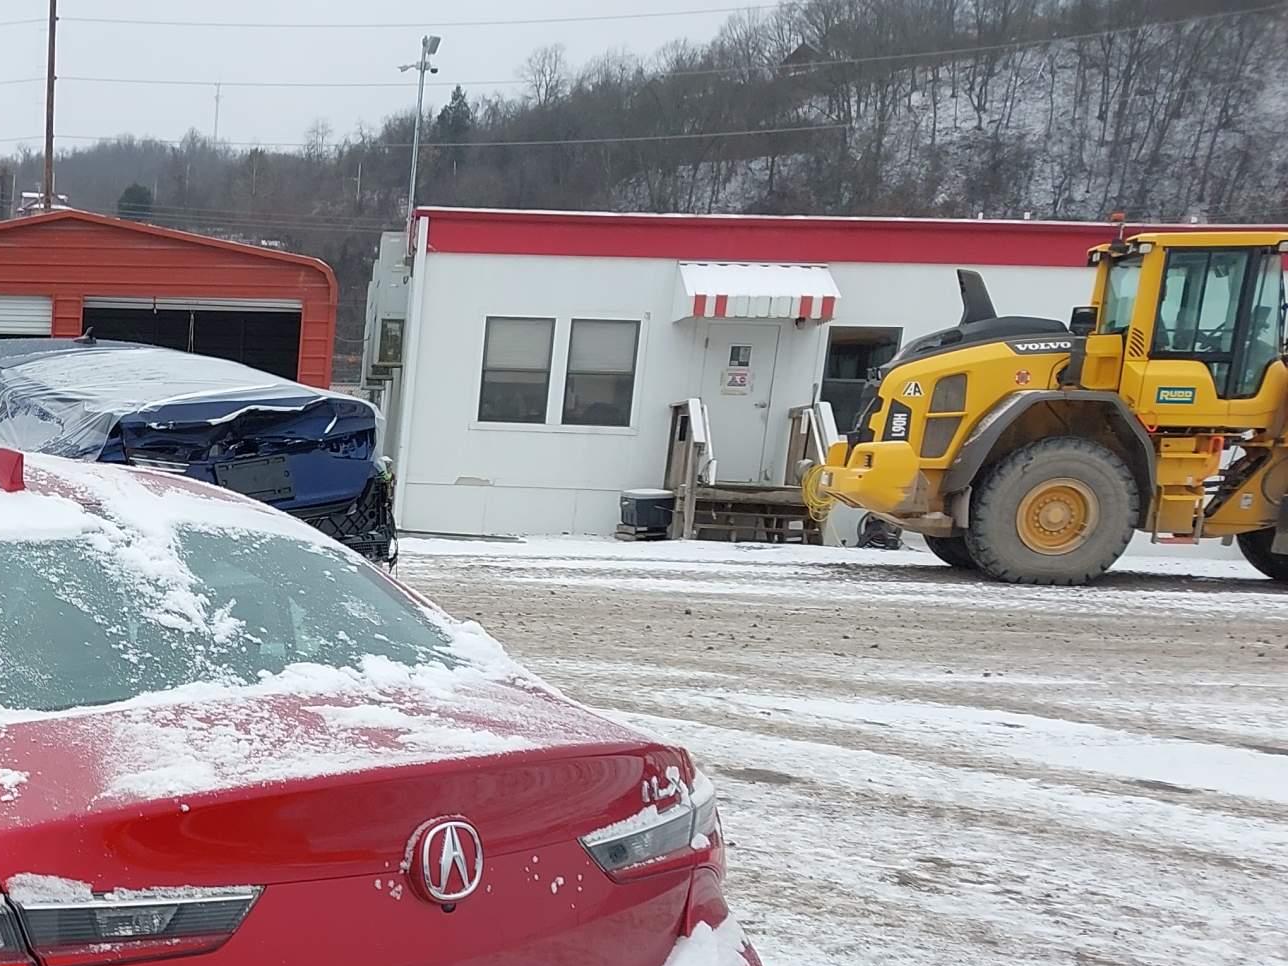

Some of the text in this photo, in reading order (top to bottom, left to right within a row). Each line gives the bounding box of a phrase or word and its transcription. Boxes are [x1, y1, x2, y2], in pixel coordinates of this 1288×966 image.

[1015, 341, 1072, 351] VOLVO
[1159, 390, 1193, 401] RUDD
[891, 413, 908, 437] L90H
